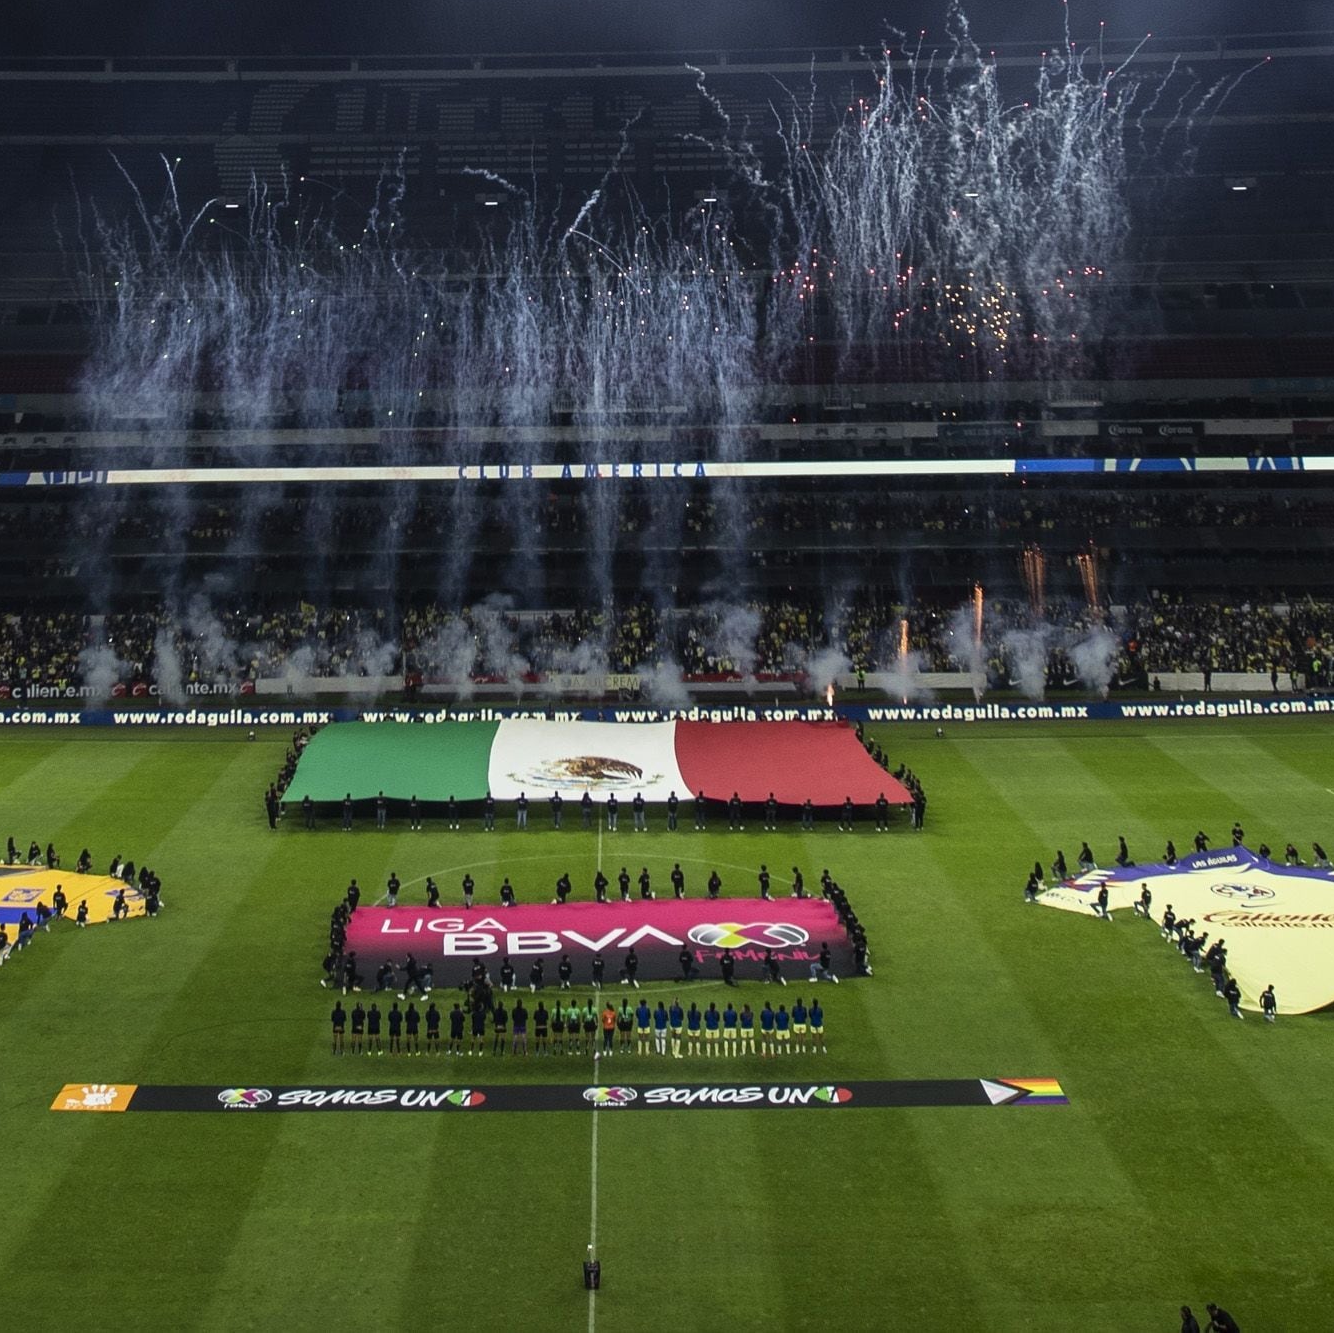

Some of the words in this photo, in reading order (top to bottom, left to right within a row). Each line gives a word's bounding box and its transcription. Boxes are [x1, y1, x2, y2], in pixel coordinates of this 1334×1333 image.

[1109, 424, 1144, 436] Corona
[1159, 424, 1194, 436] Corona
[458, 464, 533, 478] CLUB
[562, 462, 706, 478] AMERICA
[11, 683, 102, 698] cliene.mx
[114, 709, 329, 727] www.redaguila.com.mx
[869, 704, 1089, 722] www.redaguila.com.mx
[381, 917, 508, 935] LIGA
[443, 924, 684, 956] BBVA
[277, 1089, 398, 1107] SOMOS
[643, 1087, 765, 1105] SOMOS
